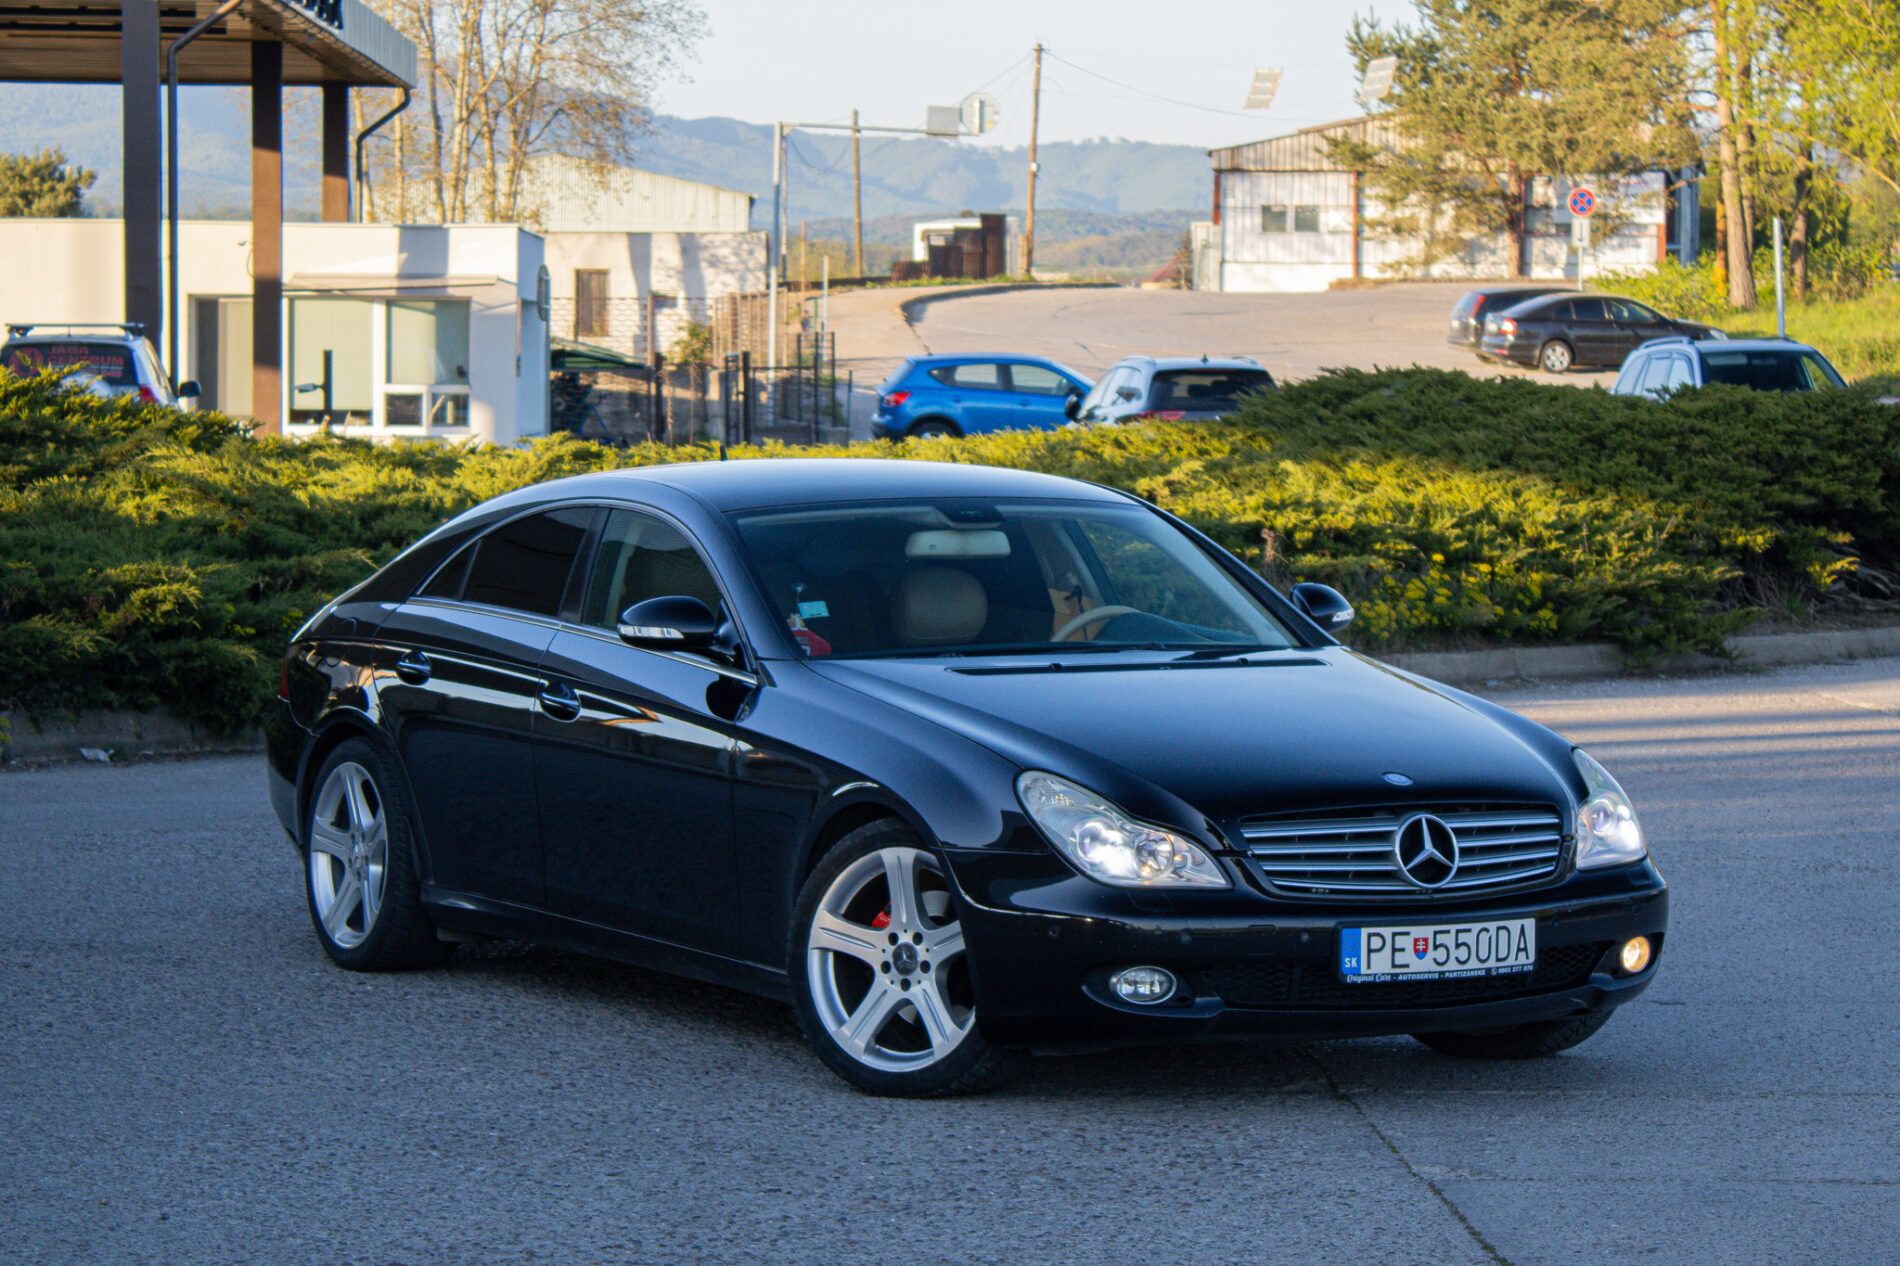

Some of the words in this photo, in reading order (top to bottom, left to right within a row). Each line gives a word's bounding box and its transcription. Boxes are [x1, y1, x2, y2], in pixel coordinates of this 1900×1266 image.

[1366, 931, 1411, 970] PE
[1432, 924, 1530, 967] 550DA
[1344, 957, 1358, 968] SK
[1397, 973, 1439, 981] AUTOSERVIS
